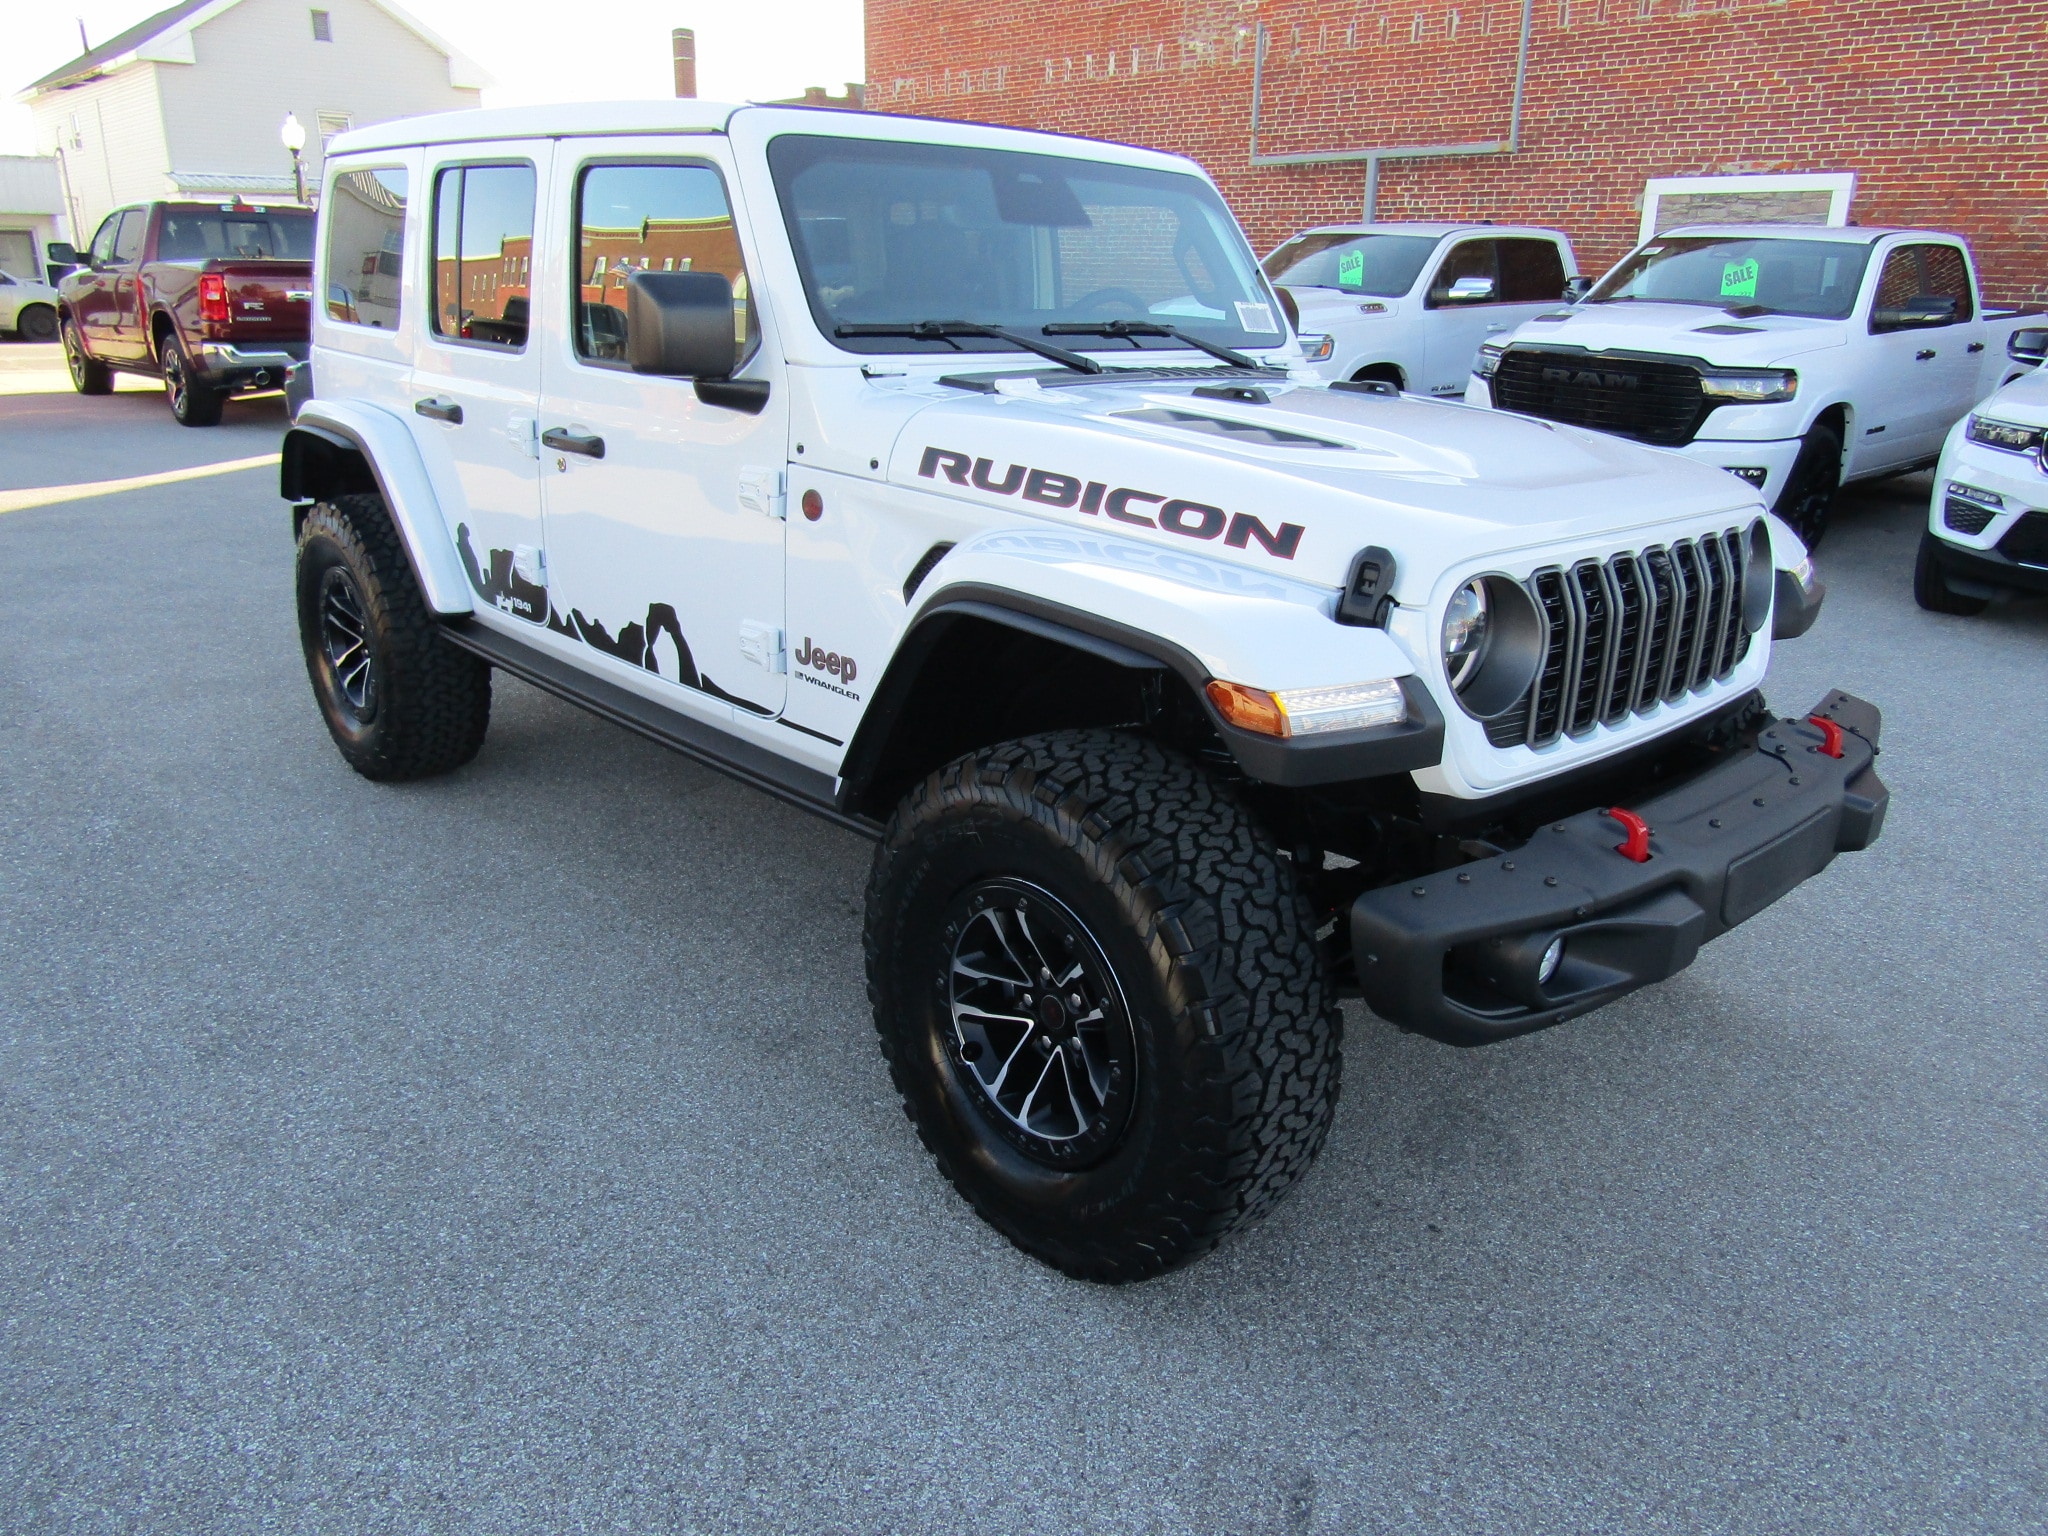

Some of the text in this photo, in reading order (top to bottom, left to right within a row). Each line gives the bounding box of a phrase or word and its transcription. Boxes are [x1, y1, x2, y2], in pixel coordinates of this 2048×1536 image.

[1340, 255, 1361, 274] SALE
[1725, 265, 1754, 287] SALE
[1541, 367, 1638, 391] RAM
[917, 446, 1306, 561] RUBICON
[513, 597, 532, 614] 1941
[794, 636, 857, 685] Jeep
[804, 673, 860, 702] WRANGLER
